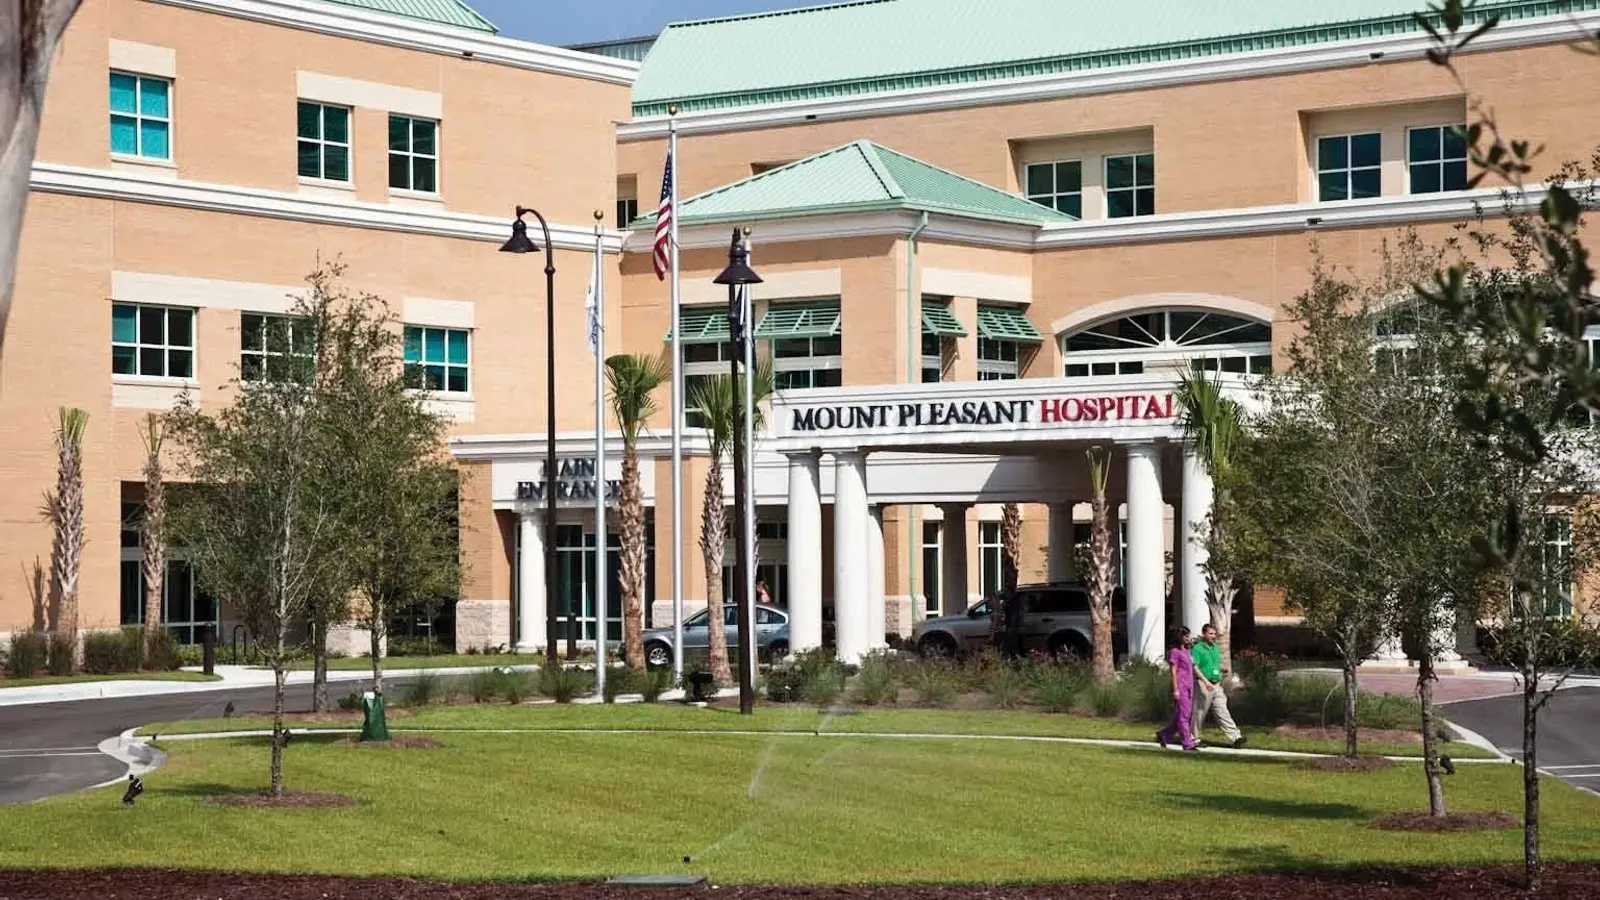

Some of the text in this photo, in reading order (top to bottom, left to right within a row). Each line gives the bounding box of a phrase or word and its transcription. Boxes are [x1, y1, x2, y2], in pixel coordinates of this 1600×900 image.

[792, 393, 1178, 431] MOUNT PLEASANT HOSPITAL
[517, 480, 622, 500] ENRANE
